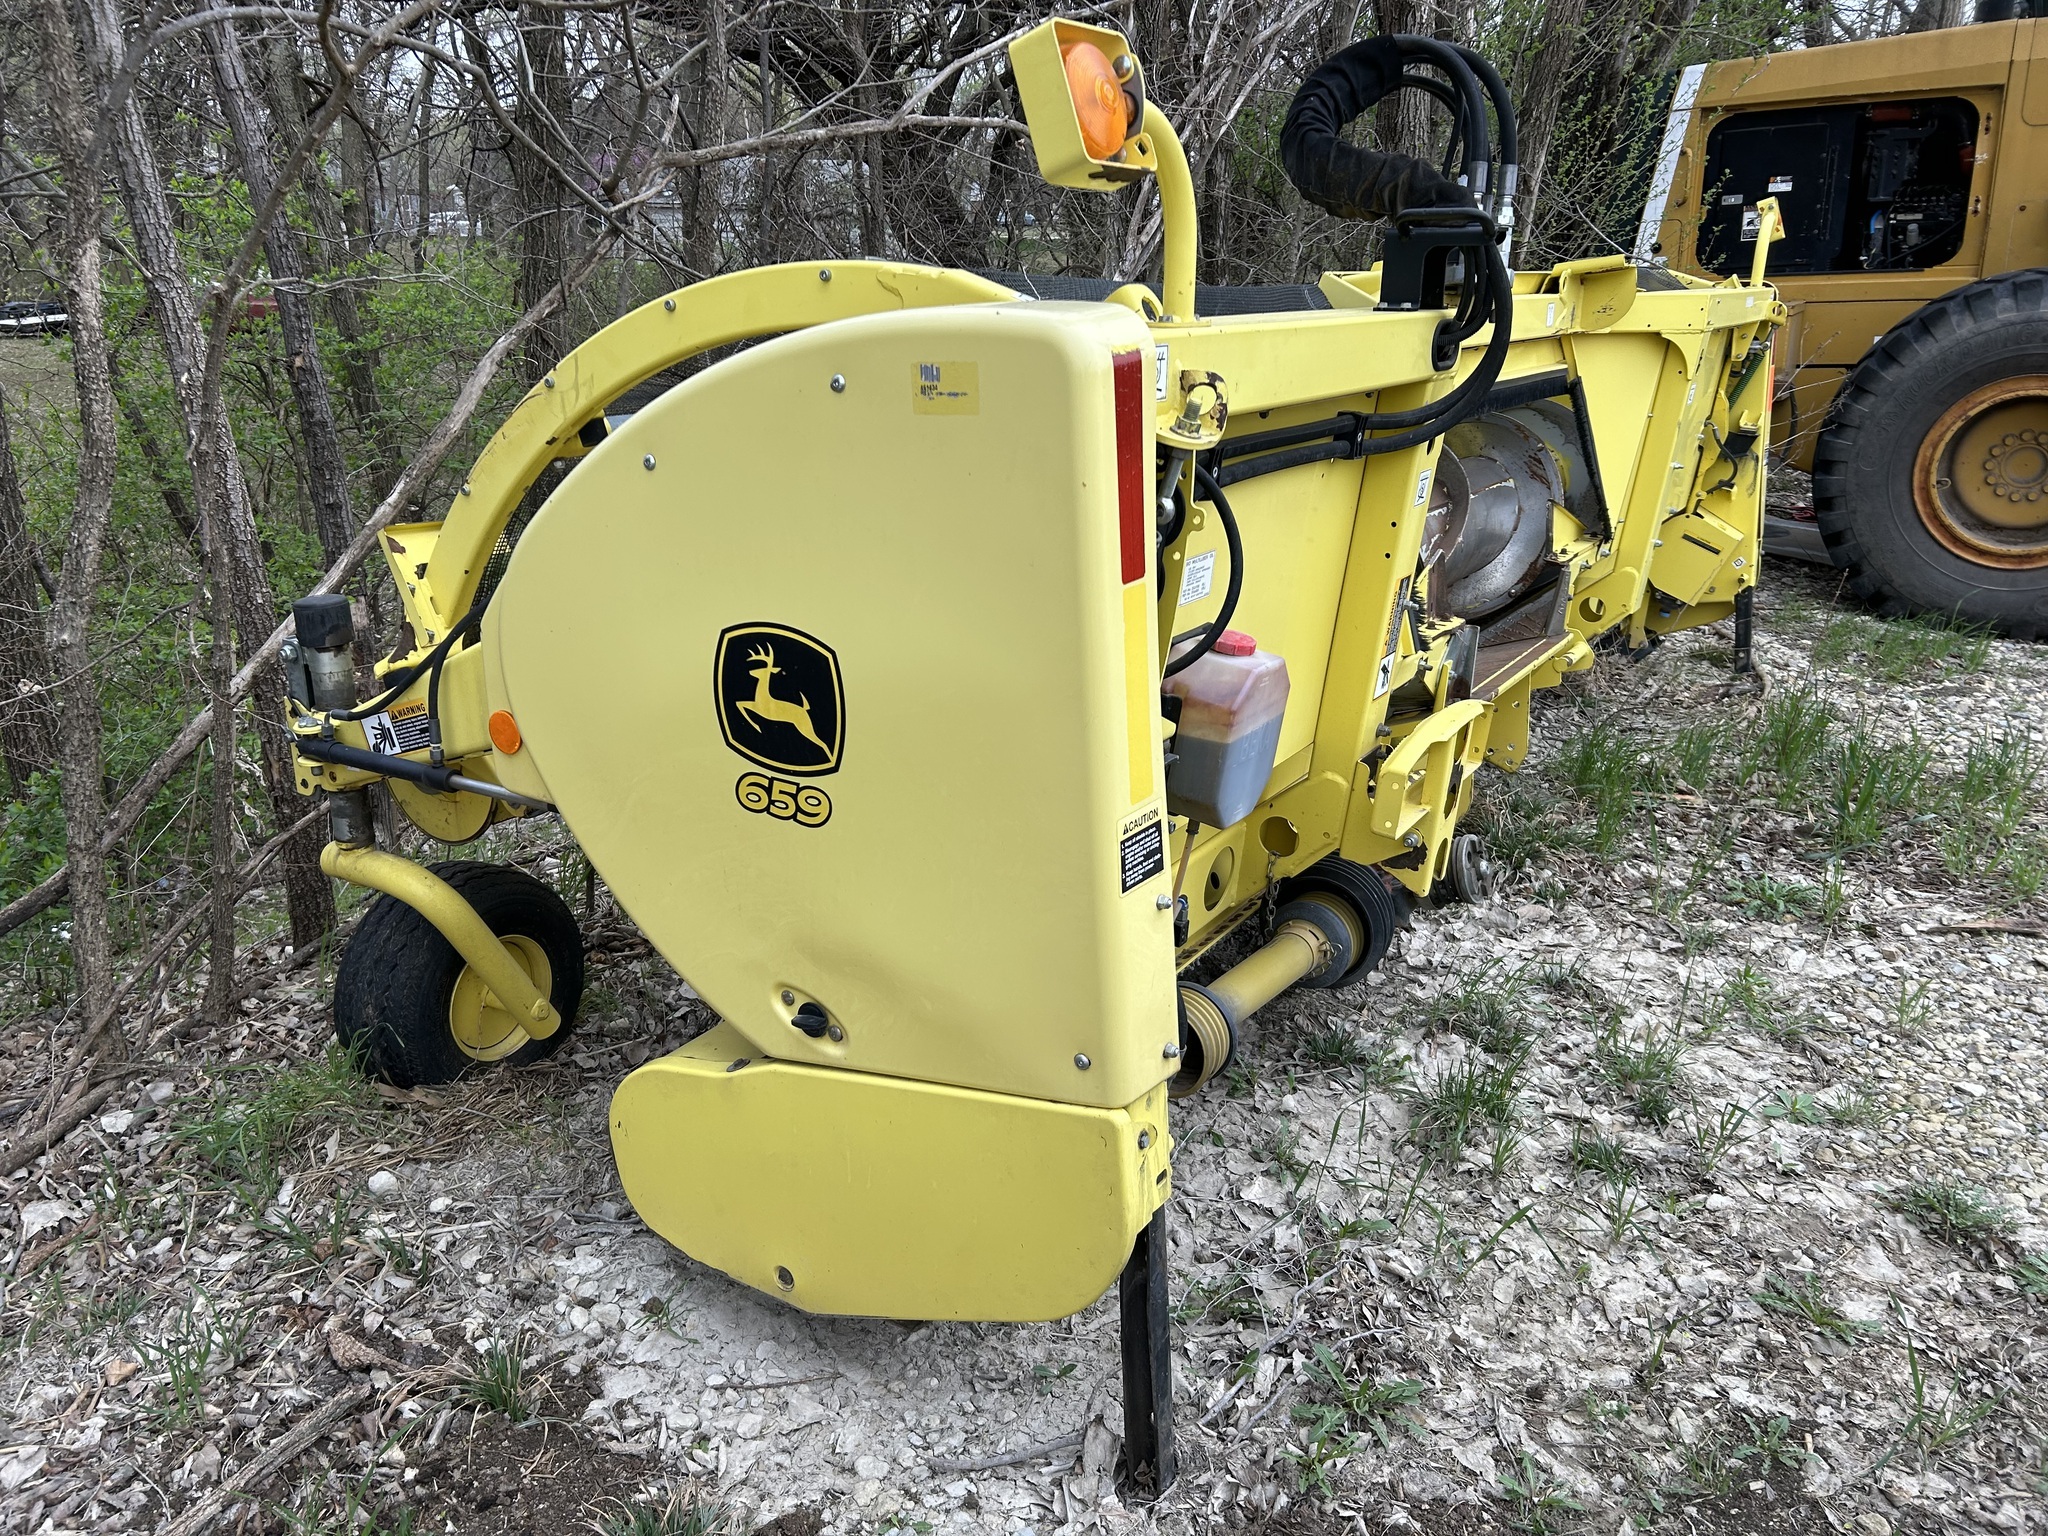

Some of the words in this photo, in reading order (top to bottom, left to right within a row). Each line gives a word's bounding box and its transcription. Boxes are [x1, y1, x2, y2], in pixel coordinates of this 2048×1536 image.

[397, 703, 426, 718] WARNING
[735, 771, 832, 828] 659
[1128, 807, 1159, 832] CAUTION
